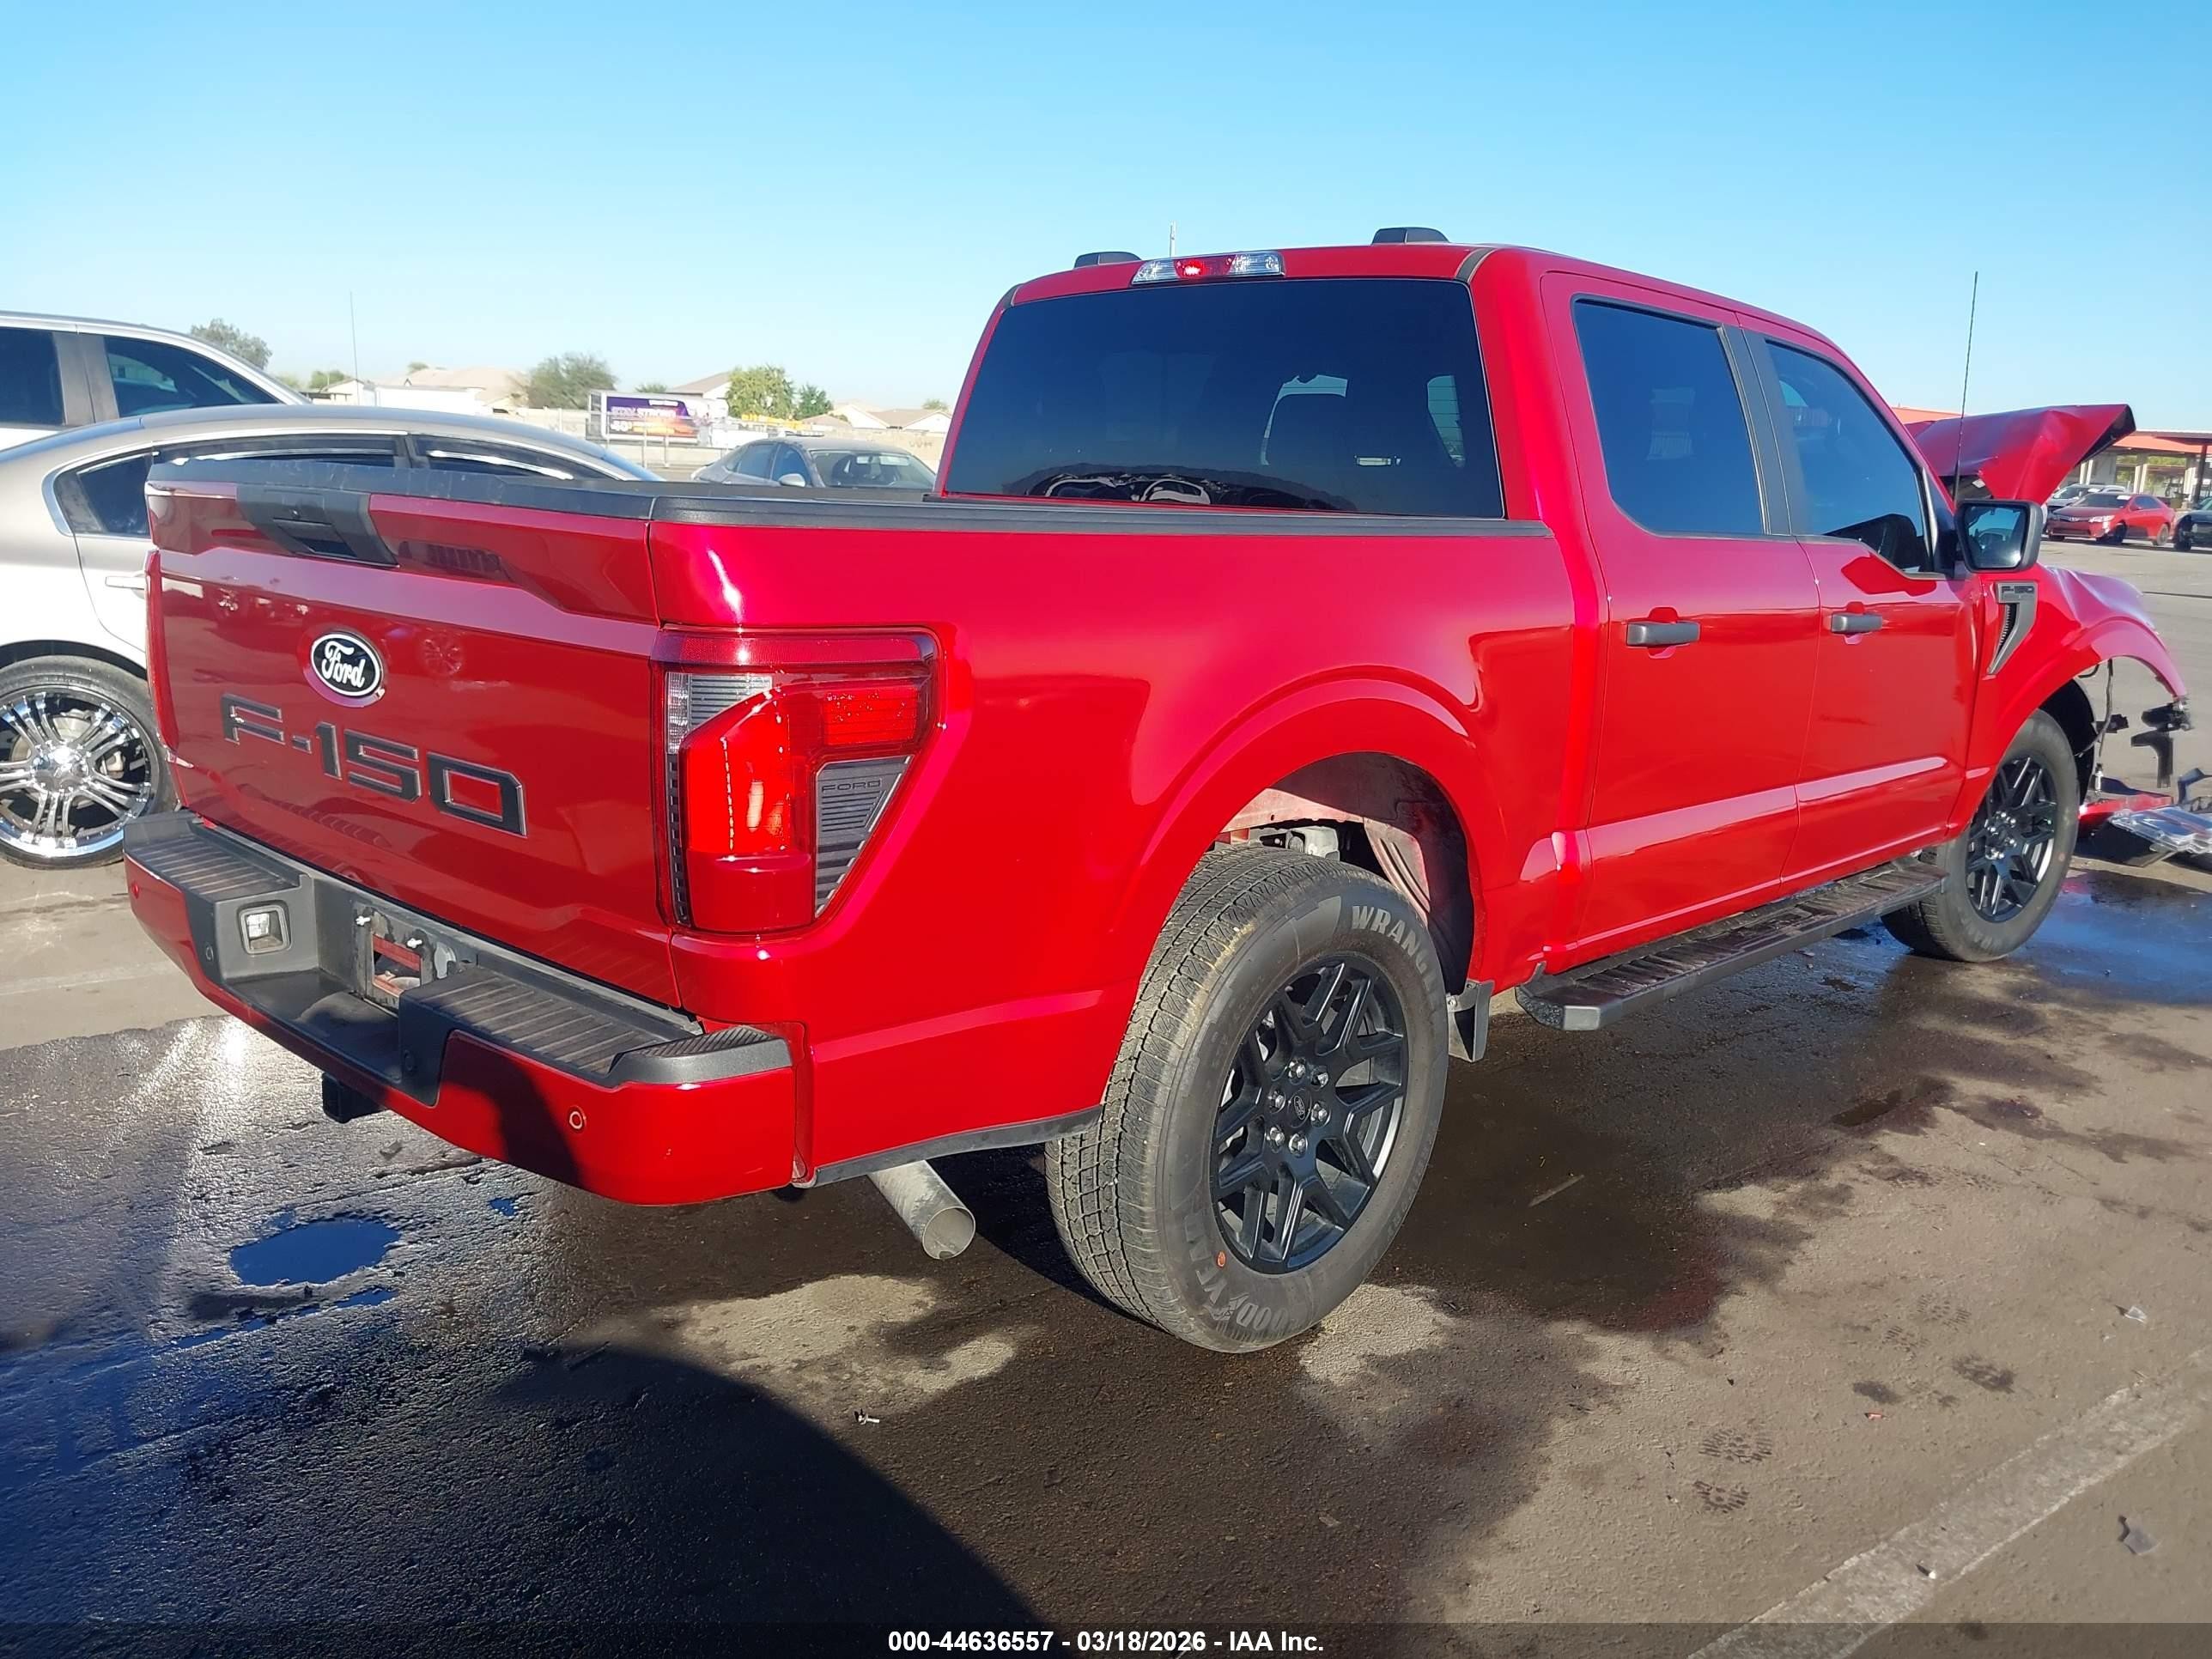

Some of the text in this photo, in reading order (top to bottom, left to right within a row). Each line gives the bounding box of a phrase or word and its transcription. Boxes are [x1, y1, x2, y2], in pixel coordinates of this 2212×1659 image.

[321, 641, 366, 688] Ford
[222, 693, 528, 839] F-150
[821, 779, 882, 792] FORD
